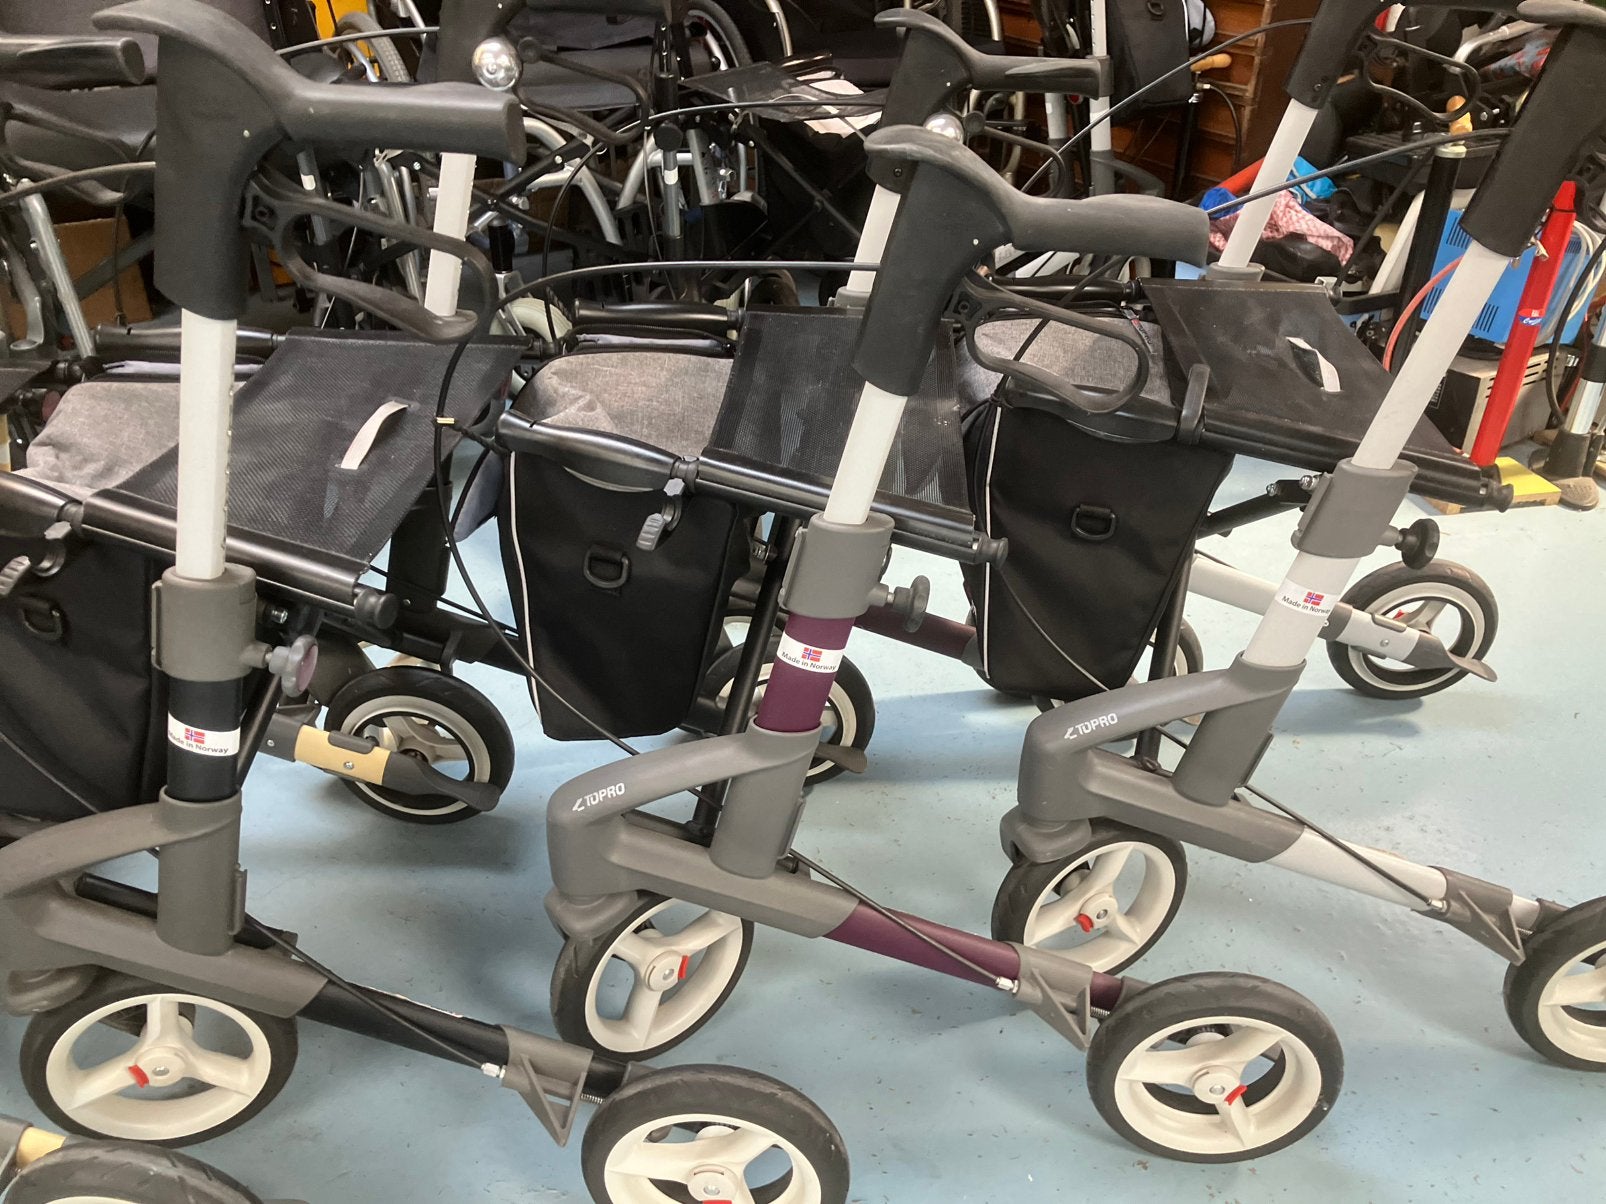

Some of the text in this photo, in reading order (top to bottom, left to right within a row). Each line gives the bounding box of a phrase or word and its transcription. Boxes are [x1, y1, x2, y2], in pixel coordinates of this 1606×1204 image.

[1282, 595, 1301, 608] Made
[781, 651, 801, 664] Made
[809, 662, 837, 671] Norway
[1075, 713, 1118, 735] TOPRO
[195, 744, 229, 754] Norway
[583, 782, 625, 807] TOPRO
